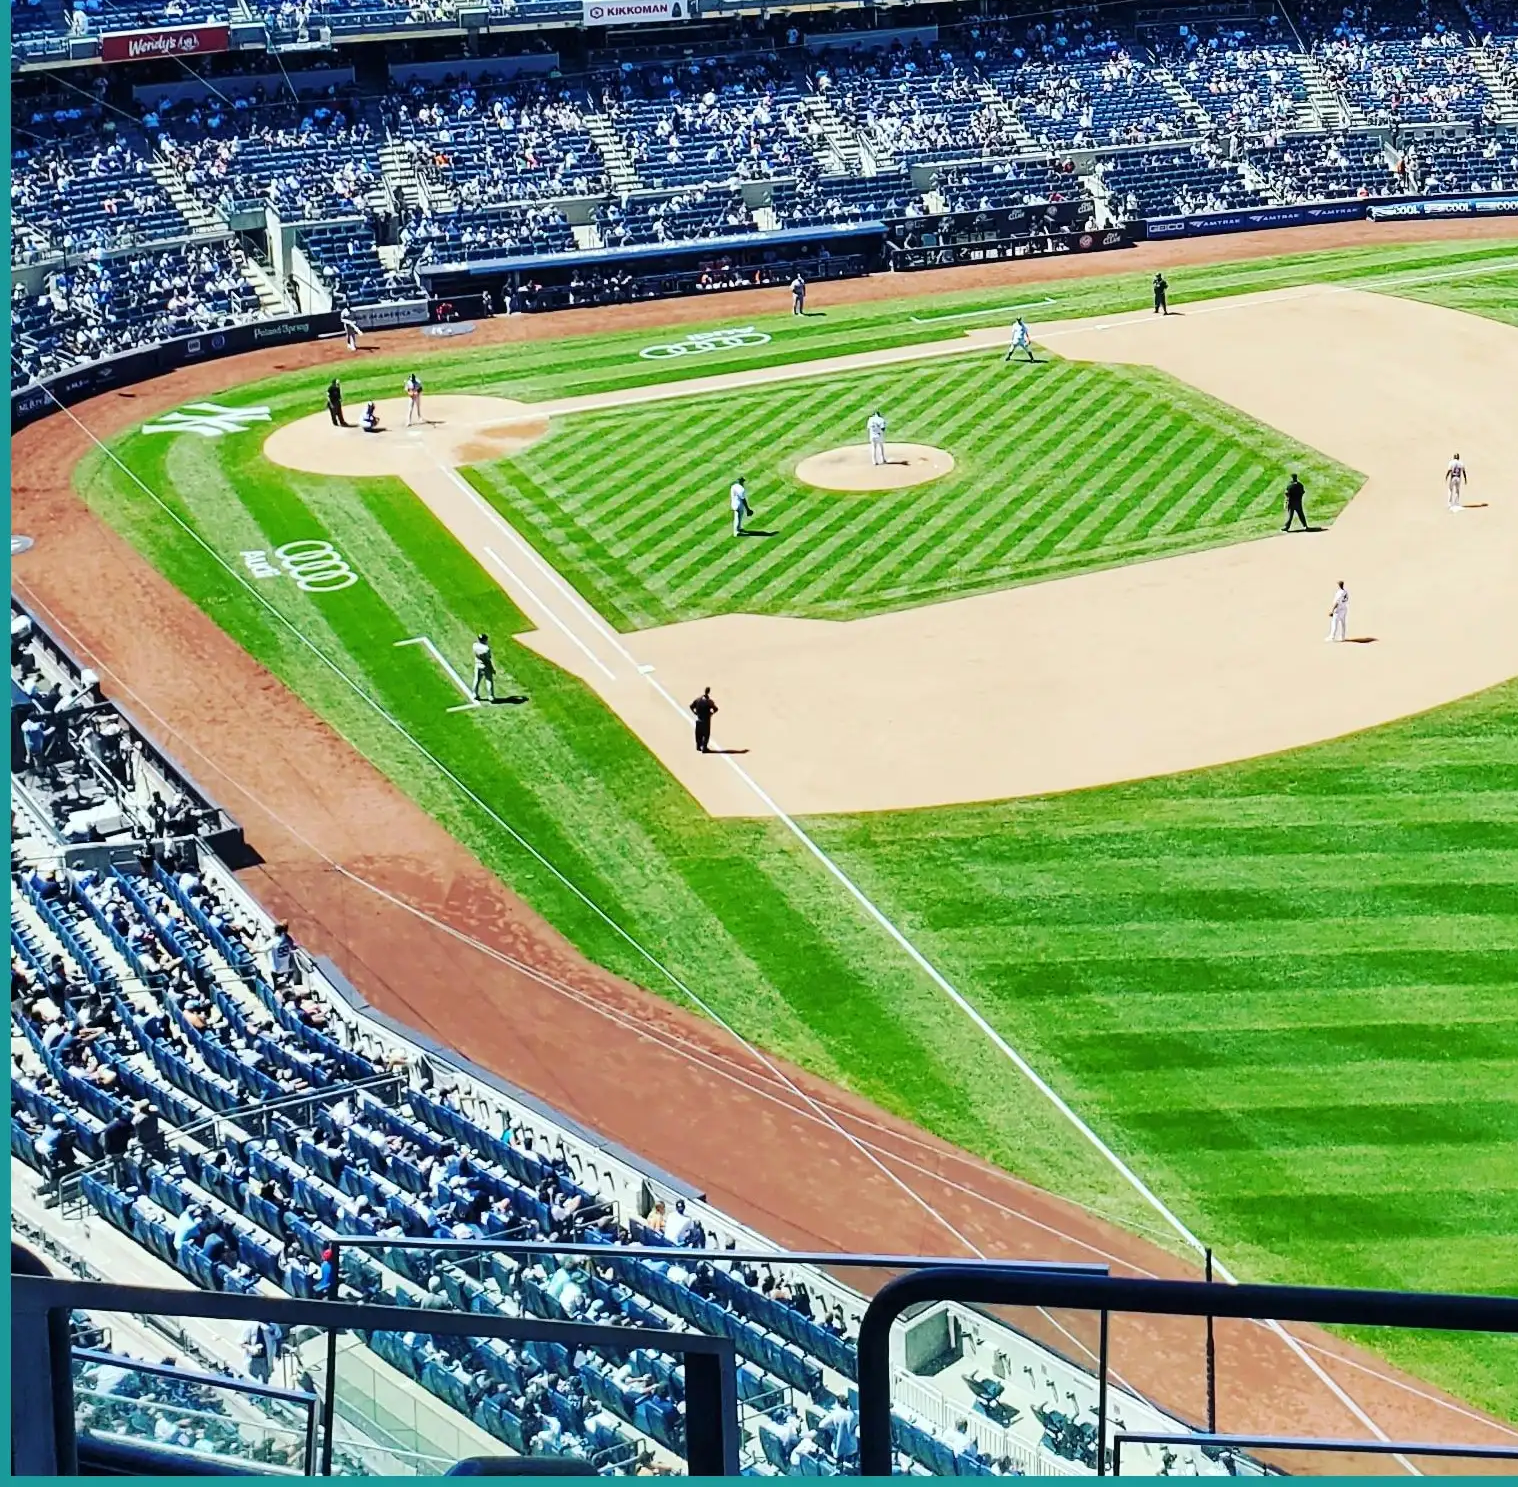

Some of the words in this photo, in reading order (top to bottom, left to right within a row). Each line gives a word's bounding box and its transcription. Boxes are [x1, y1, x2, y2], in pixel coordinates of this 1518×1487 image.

[607, 4, 668, 17] KIKKOMAN
[128, 34, 177, 57] Wendy's
[1203, 219, 1240, 227] AMTRAK
[1262, 213, 1299, 221] AMTRAK
[1149, 223, 1185, 233] GEICO
[254, 326, 281, 338] Poland
[282, 323, 309, 334] Spring
[240, 550, 281, 579] Audi
